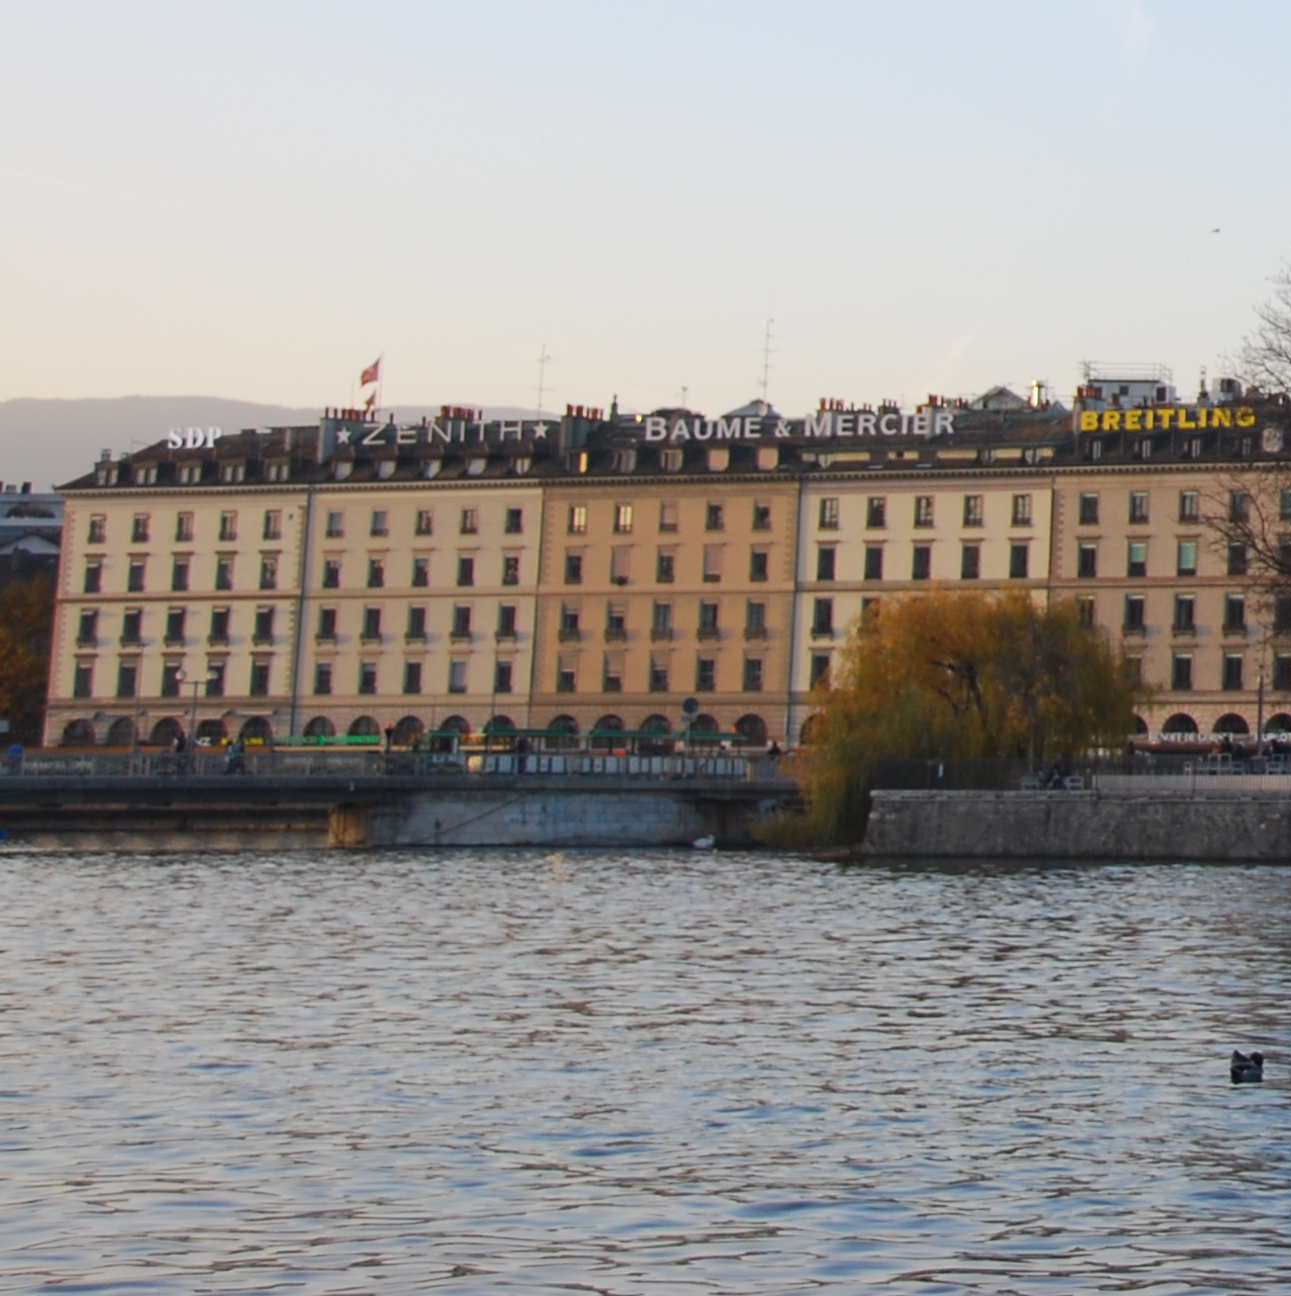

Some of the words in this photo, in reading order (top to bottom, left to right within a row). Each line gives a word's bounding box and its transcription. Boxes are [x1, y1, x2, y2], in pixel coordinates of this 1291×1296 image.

[361, 418, 523, 446] ZENITH
[645, 415, 762, 441] BAUME
[775, 418, 791, 438] &
[803, 412, 955, 437] MERCIER
[1080, 406, 1256, 432] BREITLING
[167, 425, 222, 450] SDP
